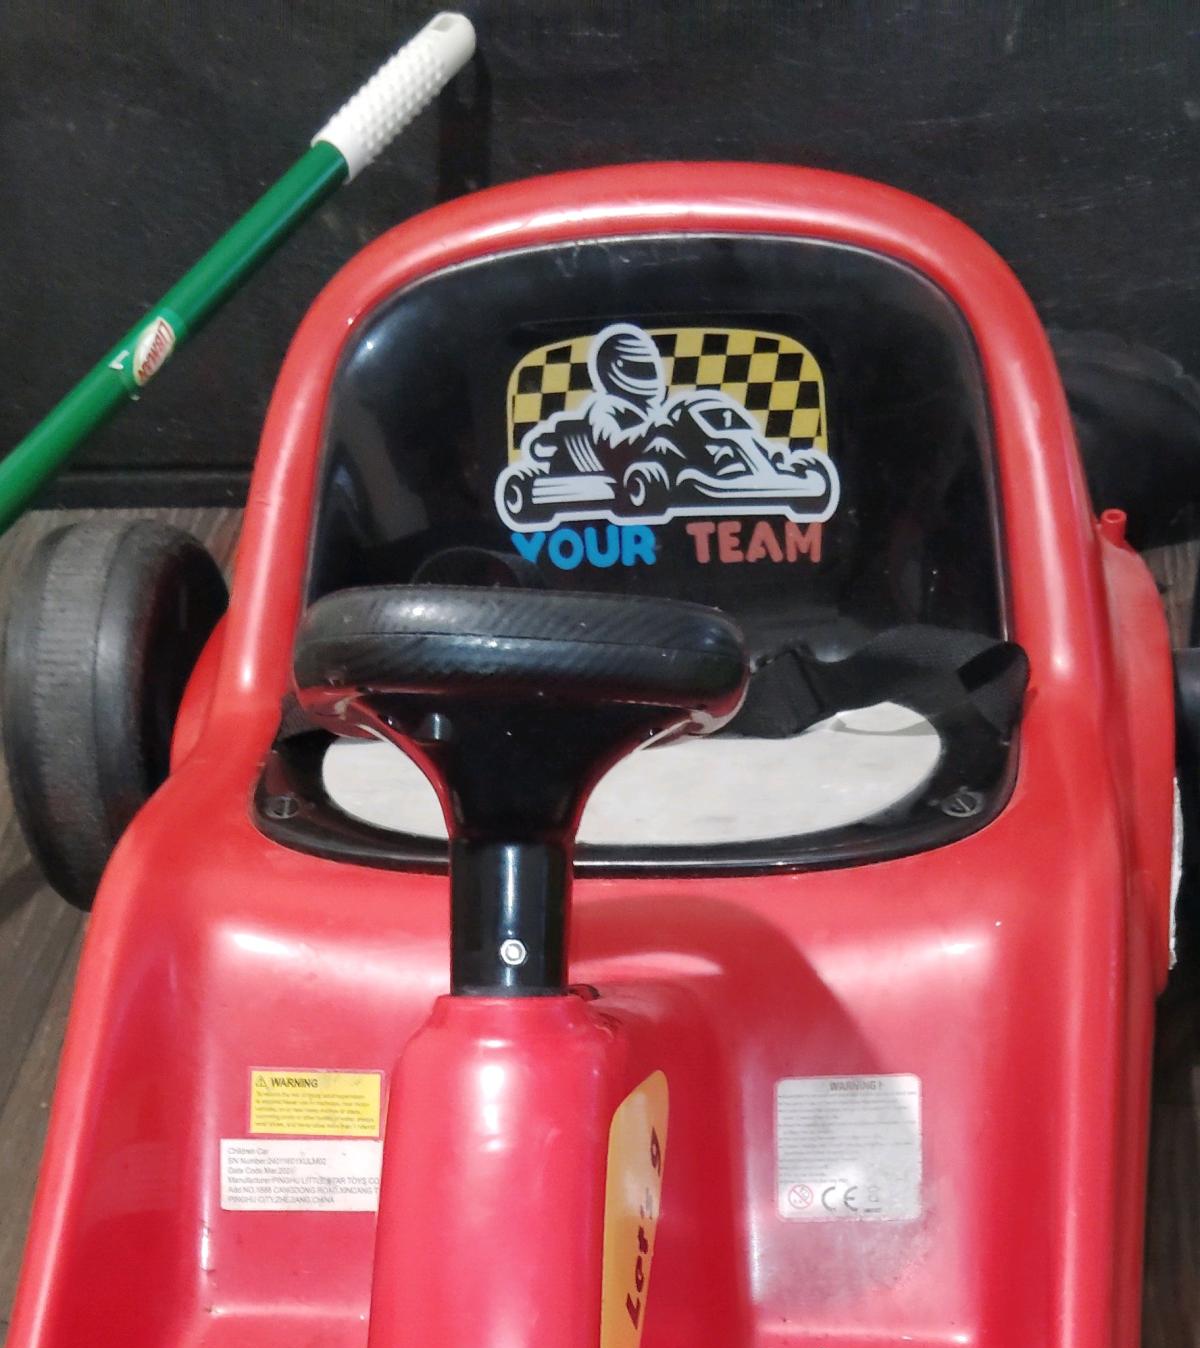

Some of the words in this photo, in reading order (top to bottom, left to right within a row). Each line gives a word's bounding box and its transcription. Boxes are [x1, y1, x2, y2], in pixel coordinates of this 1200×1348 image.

[511, 524, 657, 570] YOUR
[686, 521, 823, 564] TEAM
[271, 1078, 318, 1088] WARNING
